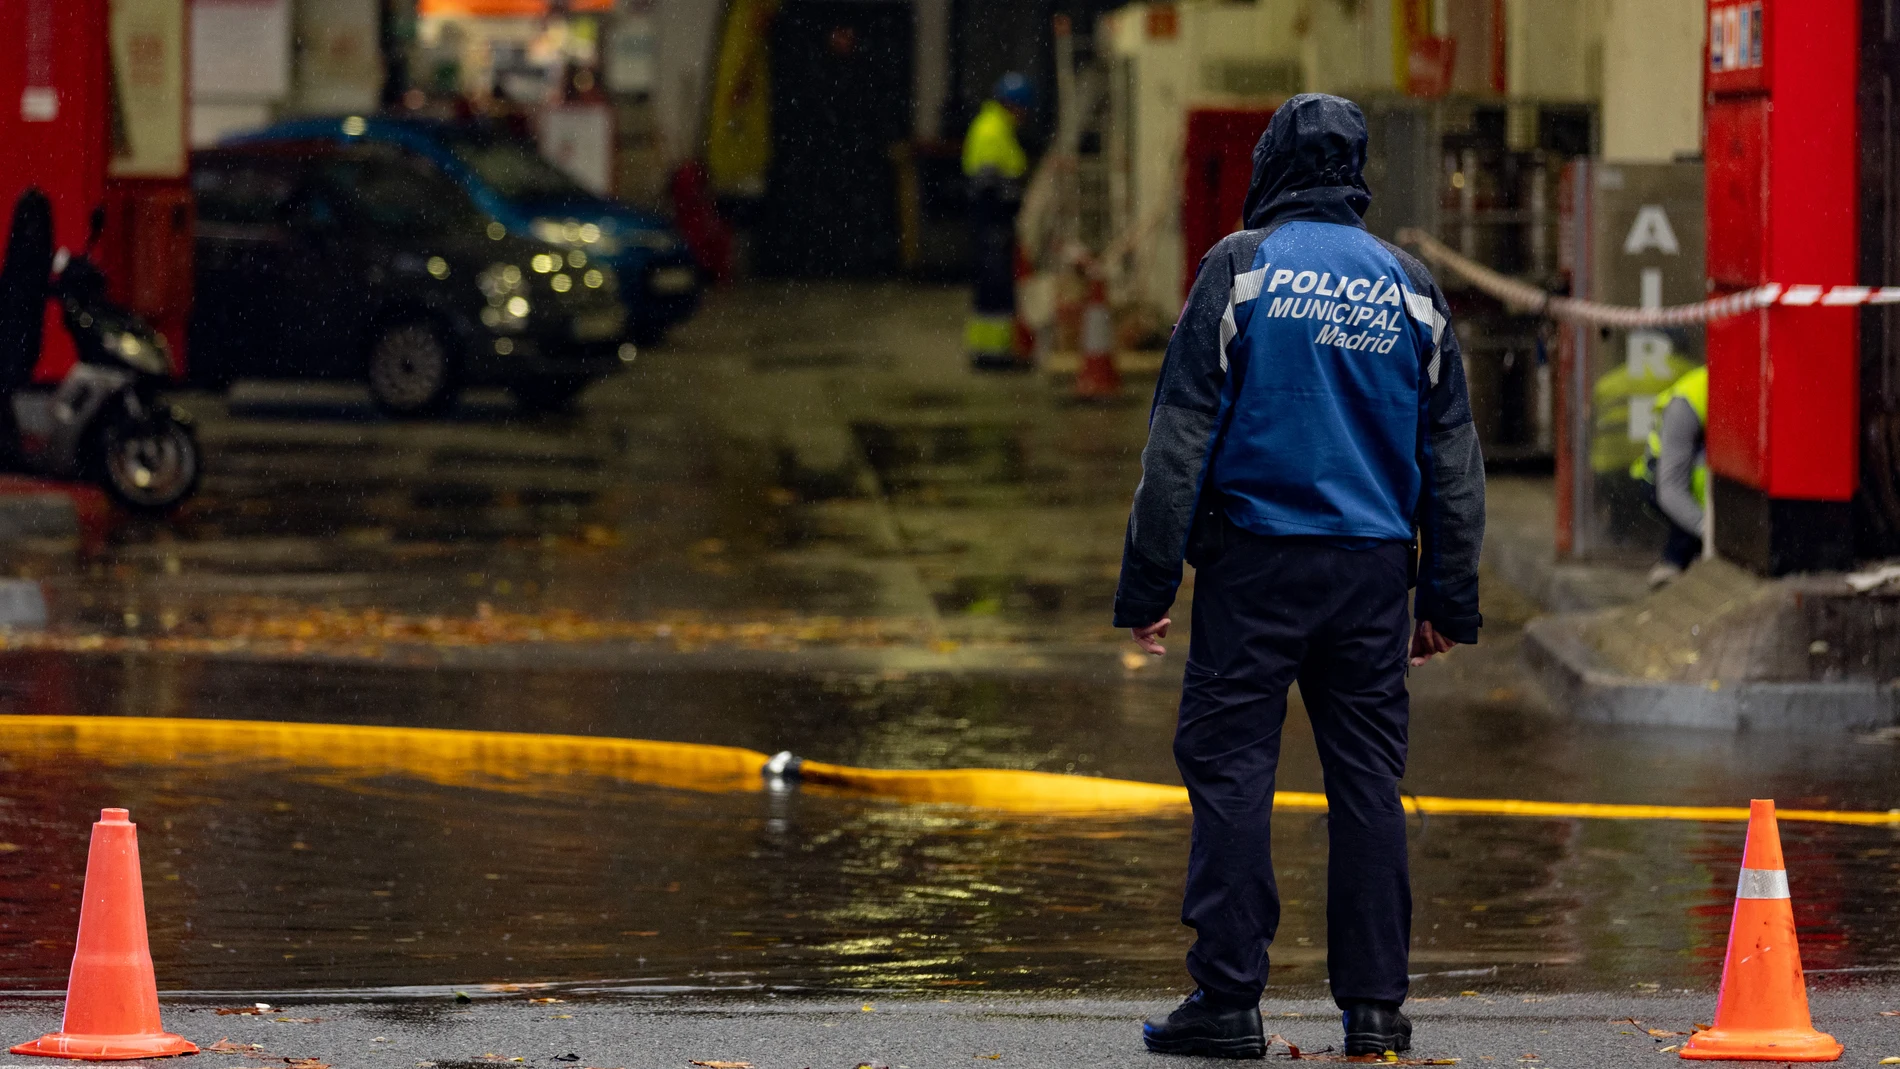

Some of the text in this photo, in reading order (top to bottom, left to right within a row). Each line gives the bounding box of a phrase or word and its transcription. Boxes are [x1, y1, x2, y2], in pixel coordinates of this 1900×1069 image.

[1267, 269, 1401, 306] POLICÍA
[1267, 297, 1402, 332] MUNICIPAL
[1314, 324, 1399, 354] Madrid
